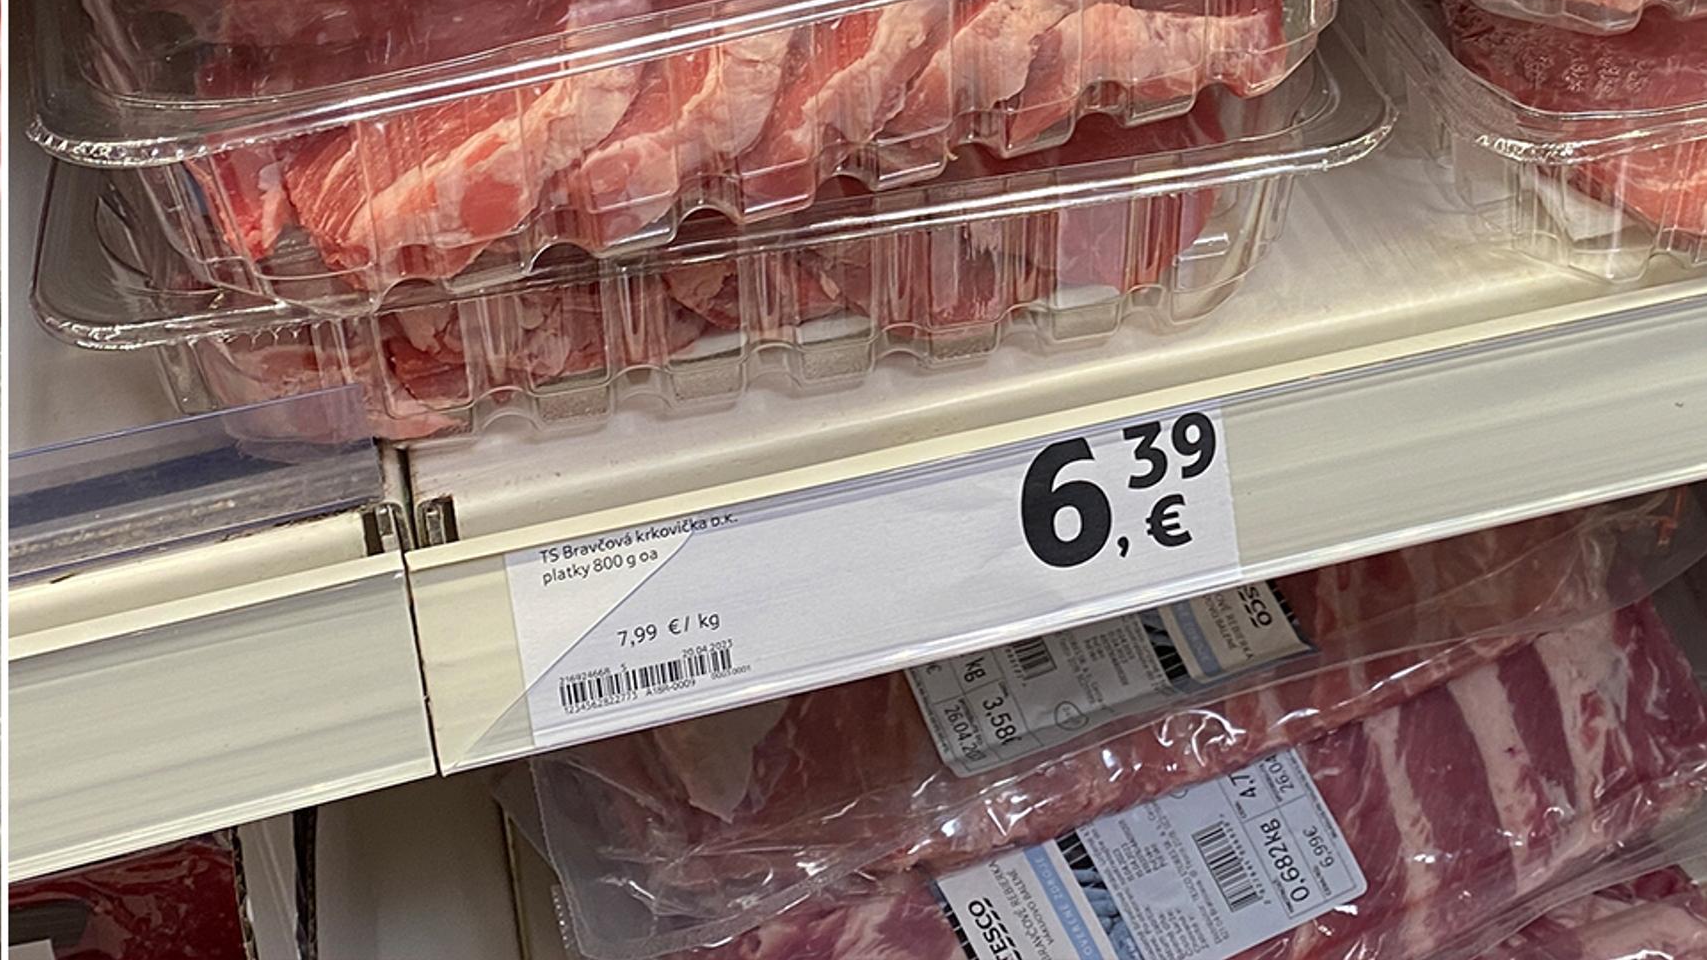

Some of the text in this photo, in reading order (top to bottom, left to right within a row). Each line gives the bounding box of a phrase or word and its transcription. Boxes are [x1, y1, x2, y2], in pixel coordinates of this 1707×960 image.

[1122, 412, 1217, 489] 39
[1145, 493, 1193, 547] €
[540, 548, 560, 564] TS
[562, 533, 634, 560] Bravčová
[542, 560, 591, 586] platky
[593, 553, 624, 574] 800
[626, 554, 637, 569] g
[617, 624, 657, 648] 7,99
[697, 613, 720, 631] kg
[1301, 822, 1336, 870] 6,99€
[986, 858, 1021, 908] REBIERKA
[1033, 855, 1064, 900] ZDROJE
